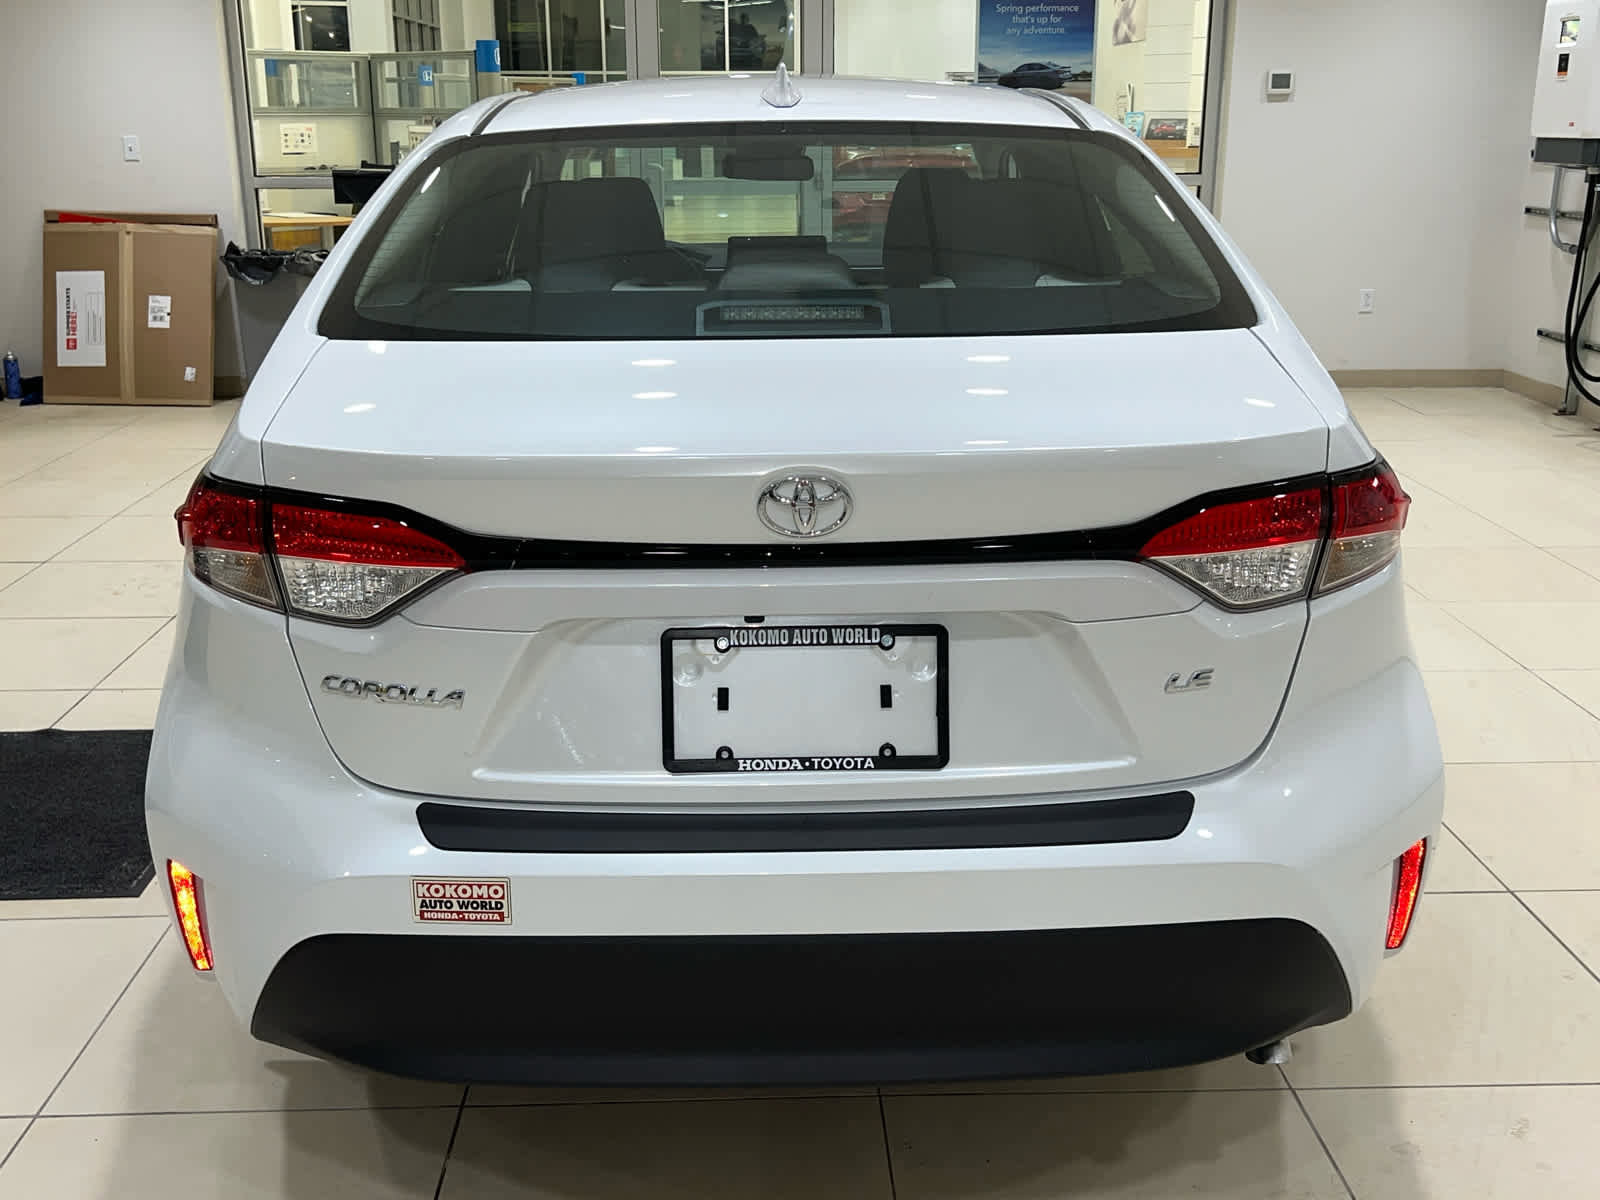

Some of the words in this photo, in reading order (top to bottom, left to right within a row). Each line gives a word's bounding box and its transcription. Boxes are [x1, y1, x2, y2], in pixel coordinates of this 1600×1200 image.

[996, 4, 1023, 14] Spring
[1025, 3, 1080, 13] performance
[1012, 15, 1035, 23] that's
[1036, 16, 1048, 24] up
[1050, 15, 1063, 23] for
[1008, 28, 1021, 36] any
[729, 628, 788, 646] KOKOMO
[792, 628, 828, 645] AUTO
[831, 628, 881, 645] WORLD
[1164, 666, 1214, 694] LE
[321, 674, 464, 711] COROLLA
[738, 758, 804, 771] HONDA
[811, 757, 875, 770] TOYOTA
[417, 885, 504, 898] KOKOMO
[420, 899, 453, 909] AUTO
[456, 900, 504, 910] WORLD
[424, 912, 459, 920] HONDA
[462, 913, 501, 921] TOYOTA
